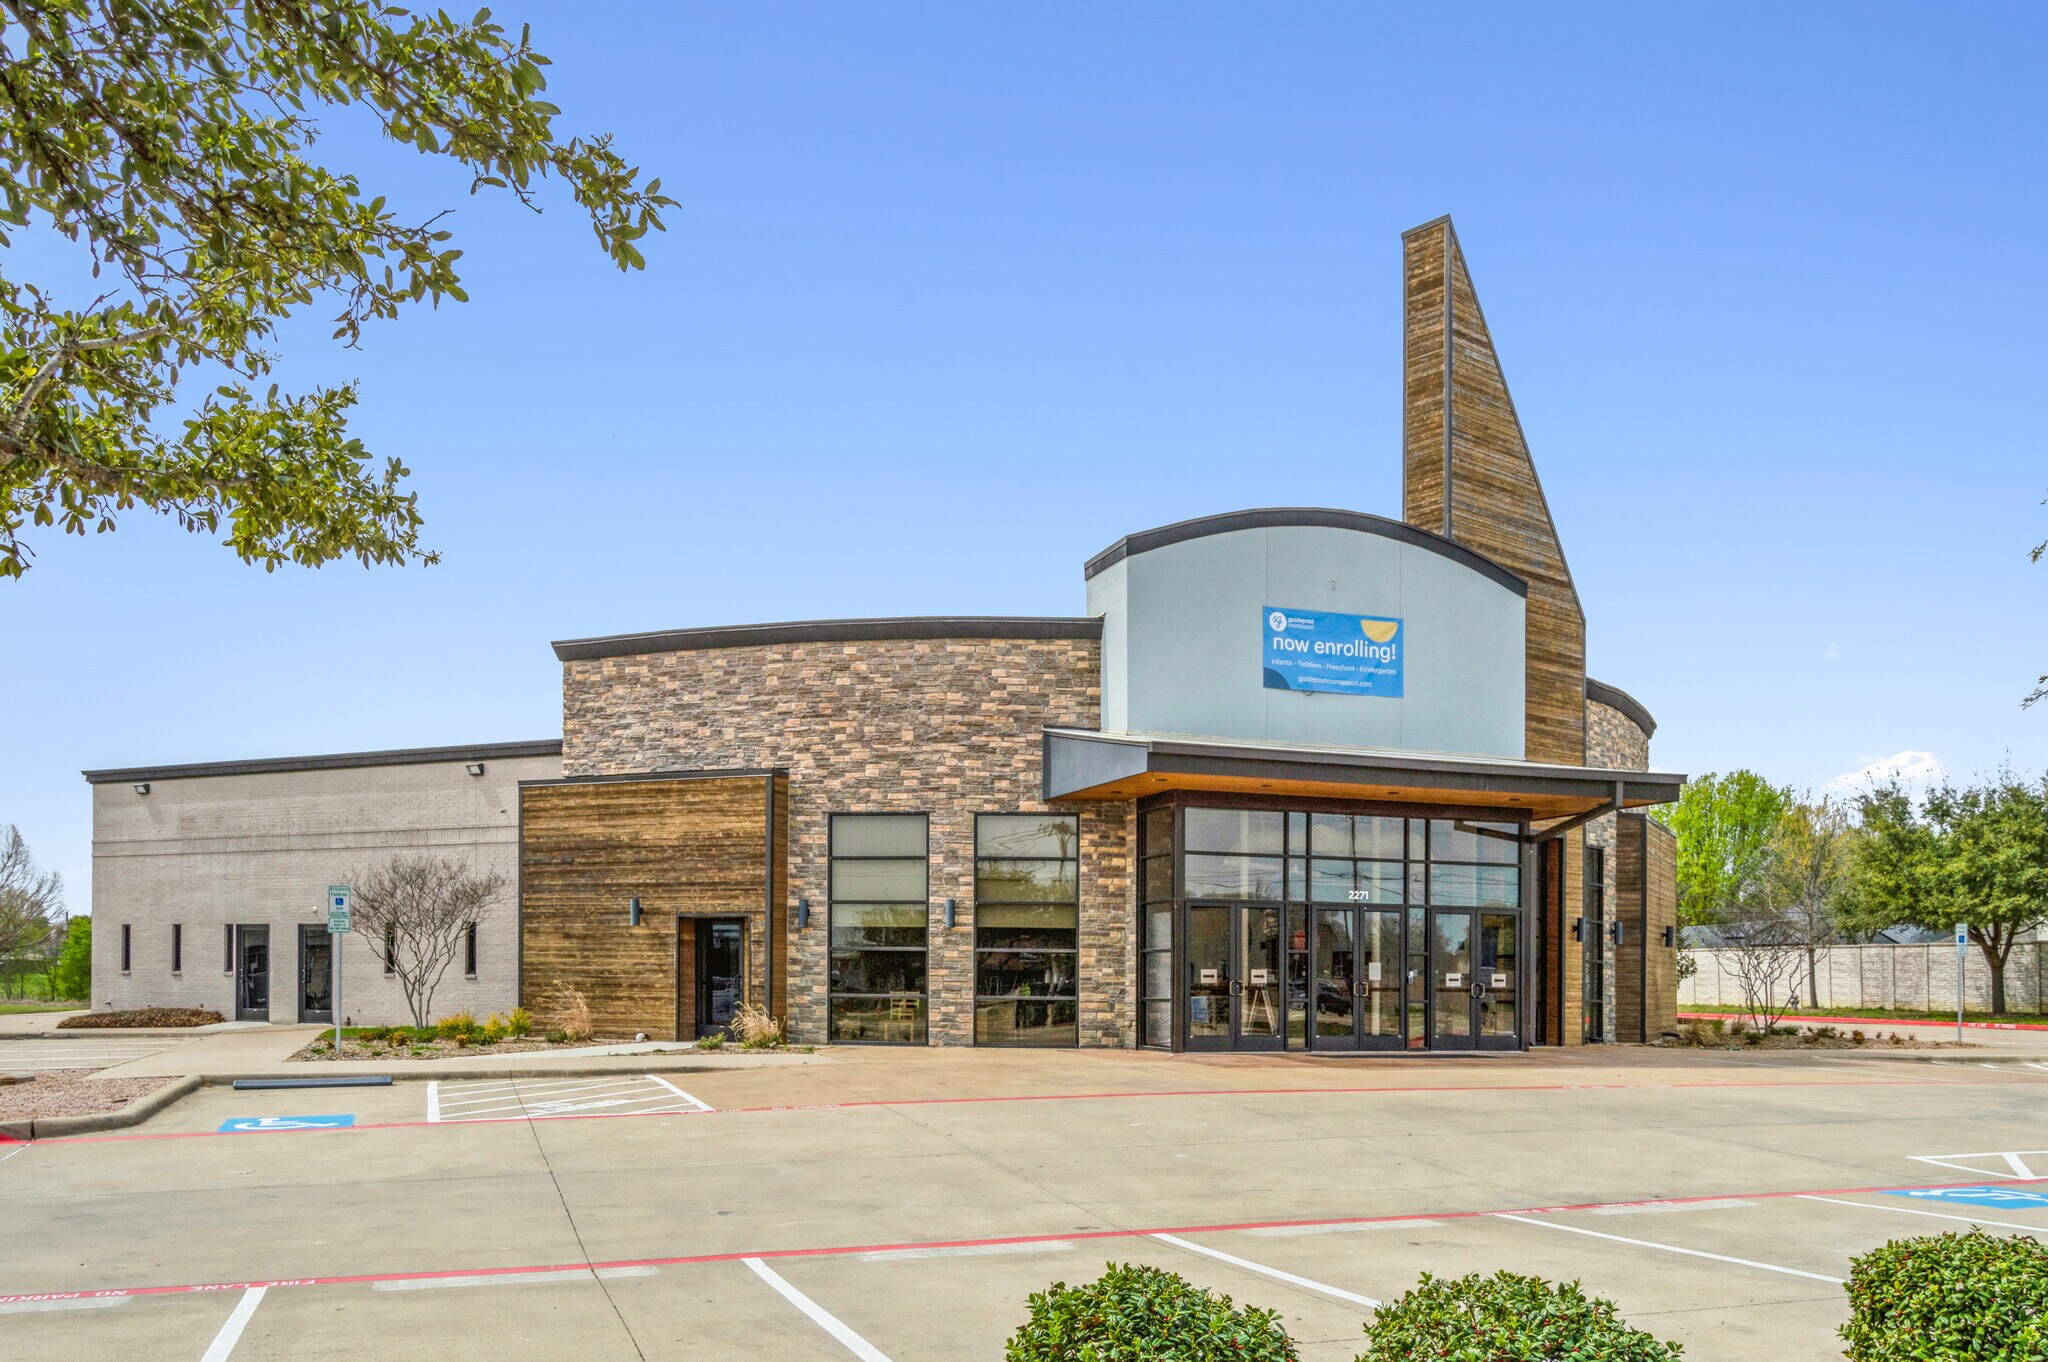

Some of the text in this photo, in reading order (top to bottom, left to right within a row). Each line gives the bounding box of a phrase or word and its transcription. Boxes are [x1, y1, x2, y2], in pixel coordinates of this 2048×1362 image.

[1288, 617, 1314, 625] guidepost
[1273, 636, 1396, 662] now enrolling!
[1271, 658, 1397, 675] Infants Toddlers Preschool Kindergarten
[1297, 675, 1372, 687] guidepostmontessori.com
[1348, 890, 1369, 900] 2271
